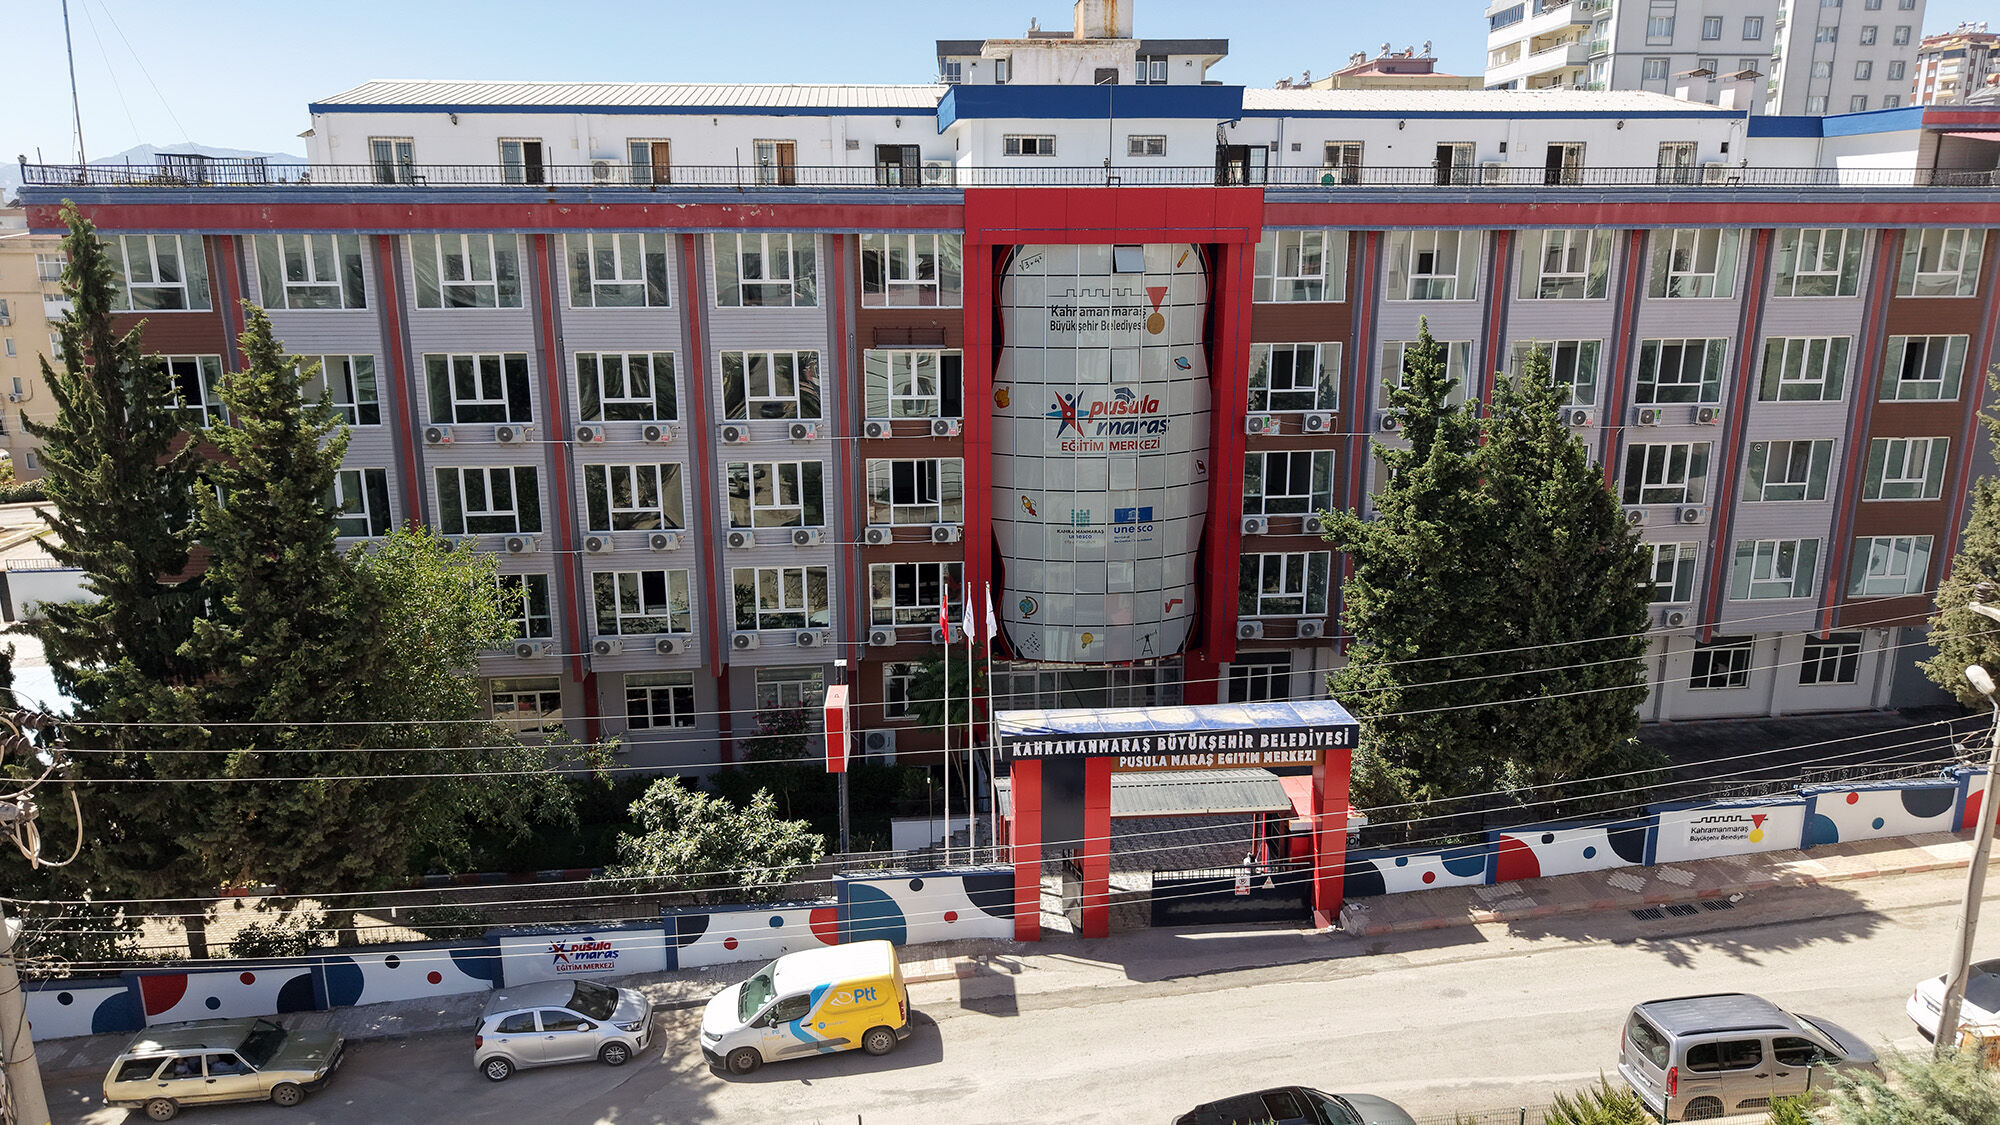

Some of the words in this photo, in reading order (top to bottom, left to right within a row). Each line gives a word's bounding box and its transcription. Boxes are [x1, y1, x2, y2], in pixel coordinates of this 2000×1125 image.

[1051, 305, 1147, 319] Kahramanmaraş
[1050, 320, 1099, 333] Büyükşehir
[1101, 319, 1146, 333] Belediyesi
[1088, 395, 1160, 423] pusula
[1096, 419, 1170, 435] maraş
[1061, 440, 1104, 452] EĞİTİM
[1109, 437, 1161, 451] MERKEZİ
[1114, 525, 1153, 534] unesco
[1012, 737, 1151, 756] KAHRAMANMARAŞ
[1157, 731, 1254, 751] BÜYÜKŞEHİR
[1260, 728, 1350, 748] BELEDİYESİ
[1119, 755, 1168, 768] PUSULA
[1171, 753, 1215, 768] MARAŞ
[1690, 826, 1749, 834] Kahramanmaraş
[1689, 834, 1720, 842] Büyükşehir
[1720, 833, 1749, 841] Belediyesi
[570, 941, 612, 956] pusula
[575, 950, 619, 960] maraş
[556, 963, 582, 972] EĞİTİM
[583, 961, 615, 970] MERKEZİ
[854, 986, 877, 1004] Ptt
